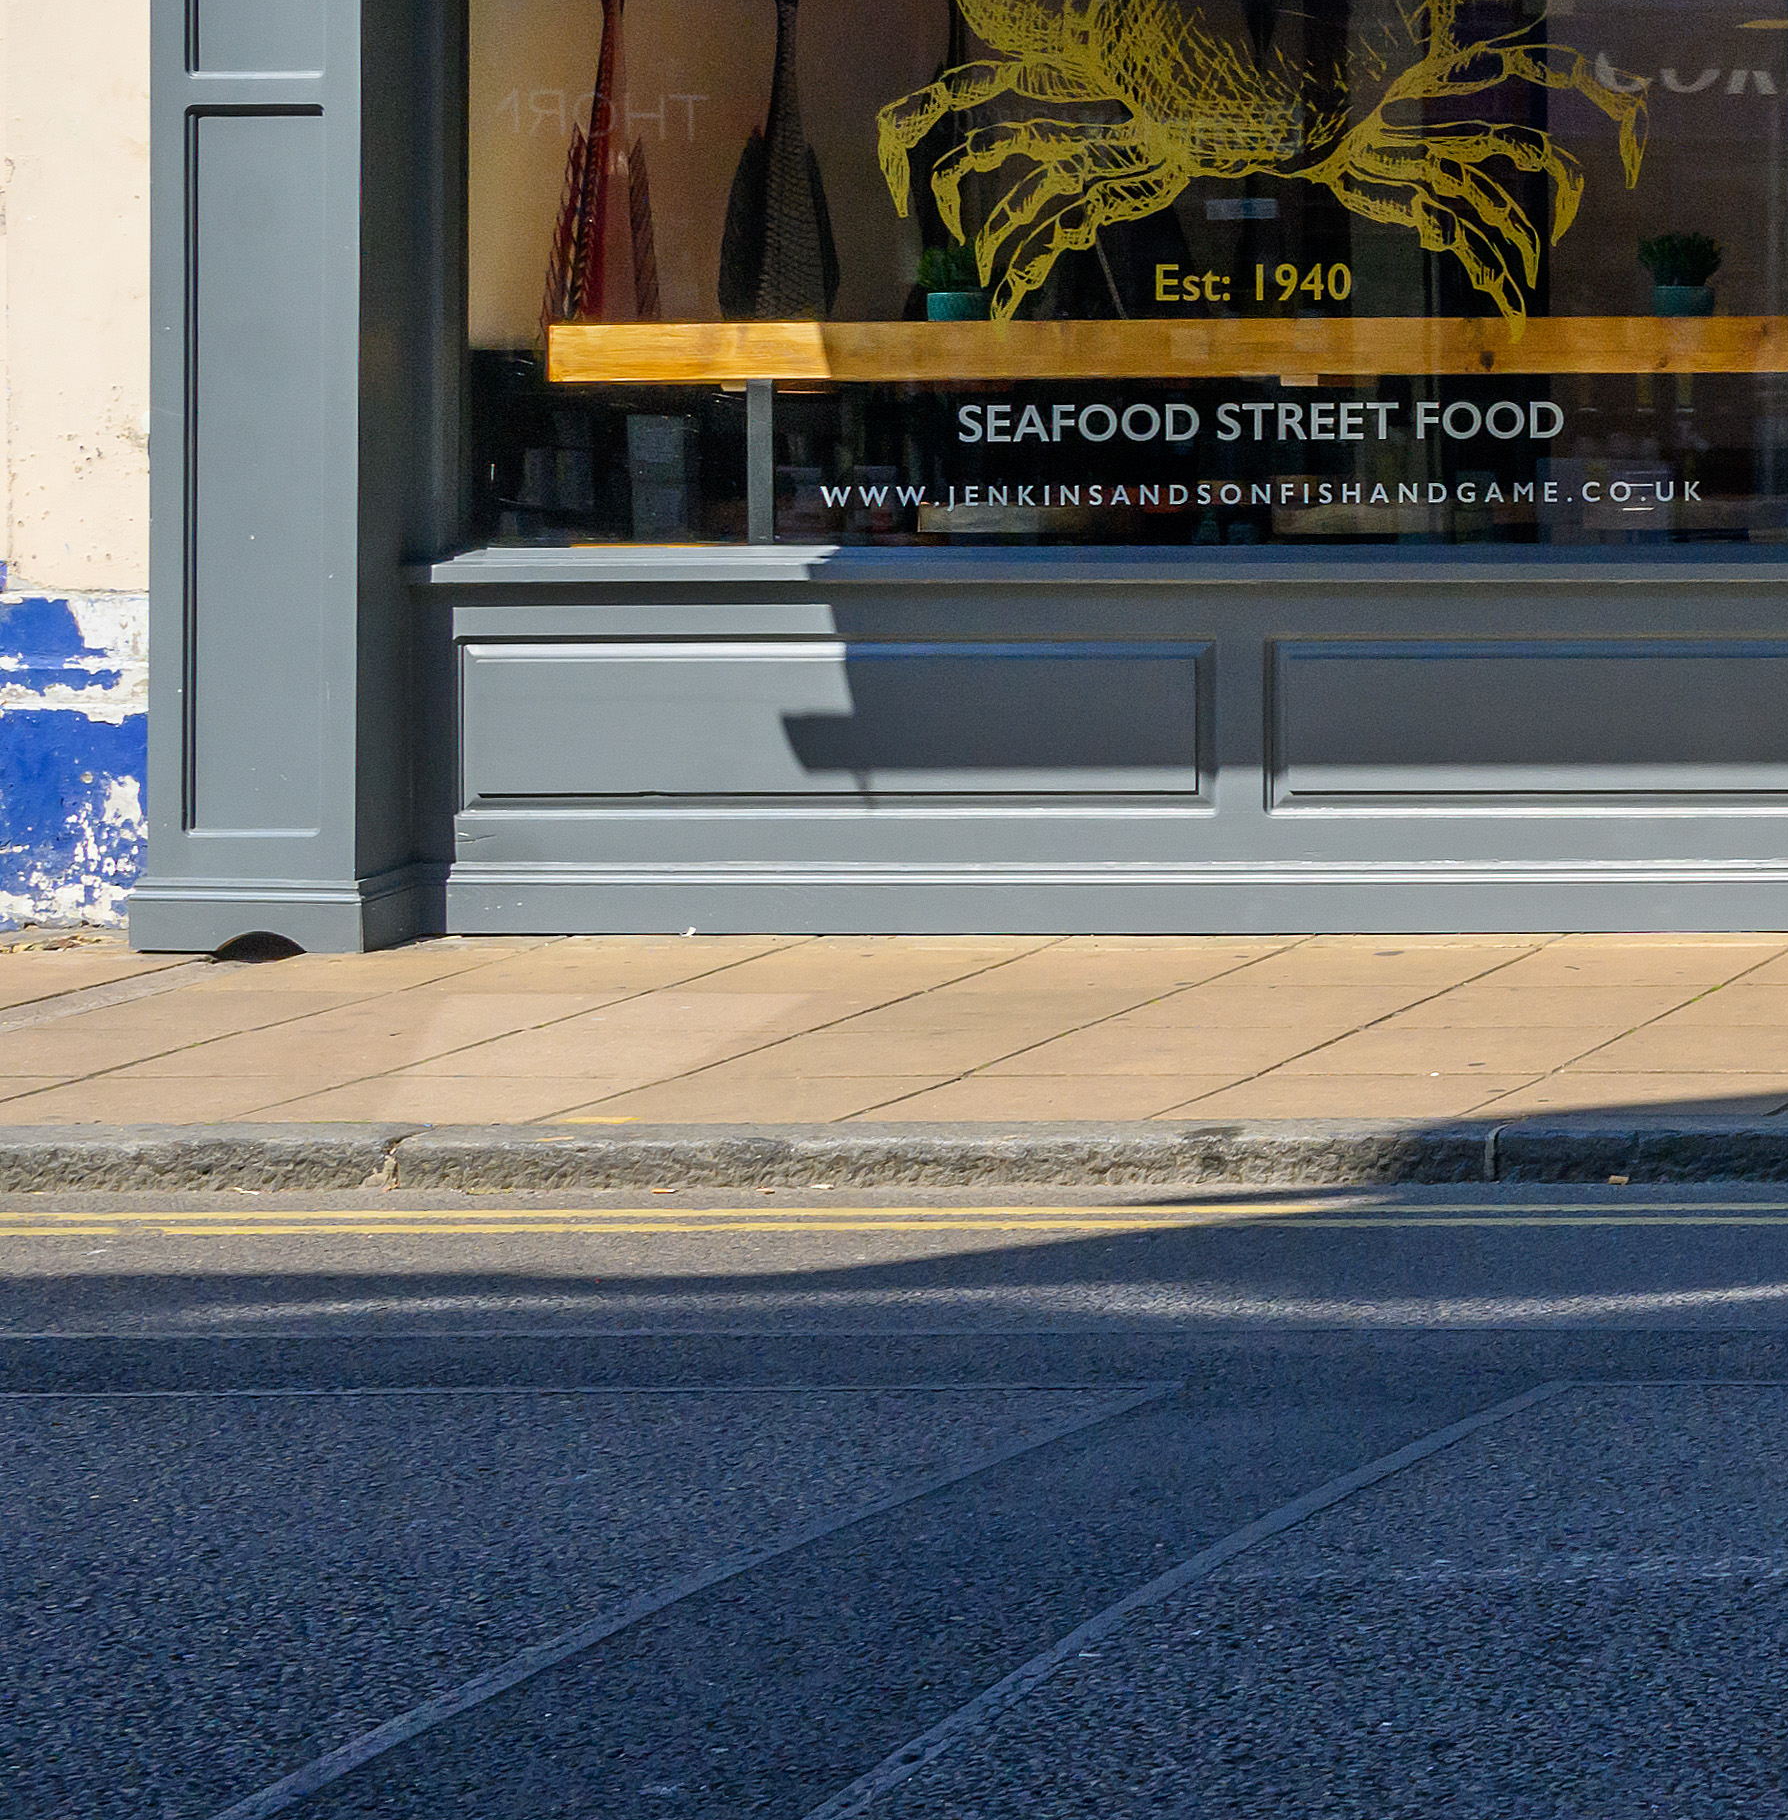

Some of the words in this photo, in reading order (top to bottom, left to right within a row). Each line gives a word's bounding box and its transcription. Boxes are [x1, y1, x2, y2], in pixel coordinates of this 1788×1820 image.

[1155, 263, 1232, 302] Est:
[1255, 262, 1353, 302] 1940
[958, 403, 1200, 443] SEAFOOD
[1216, 401, 1400, 442] STREET
[1416, 400, 1565, 440] FOOD
